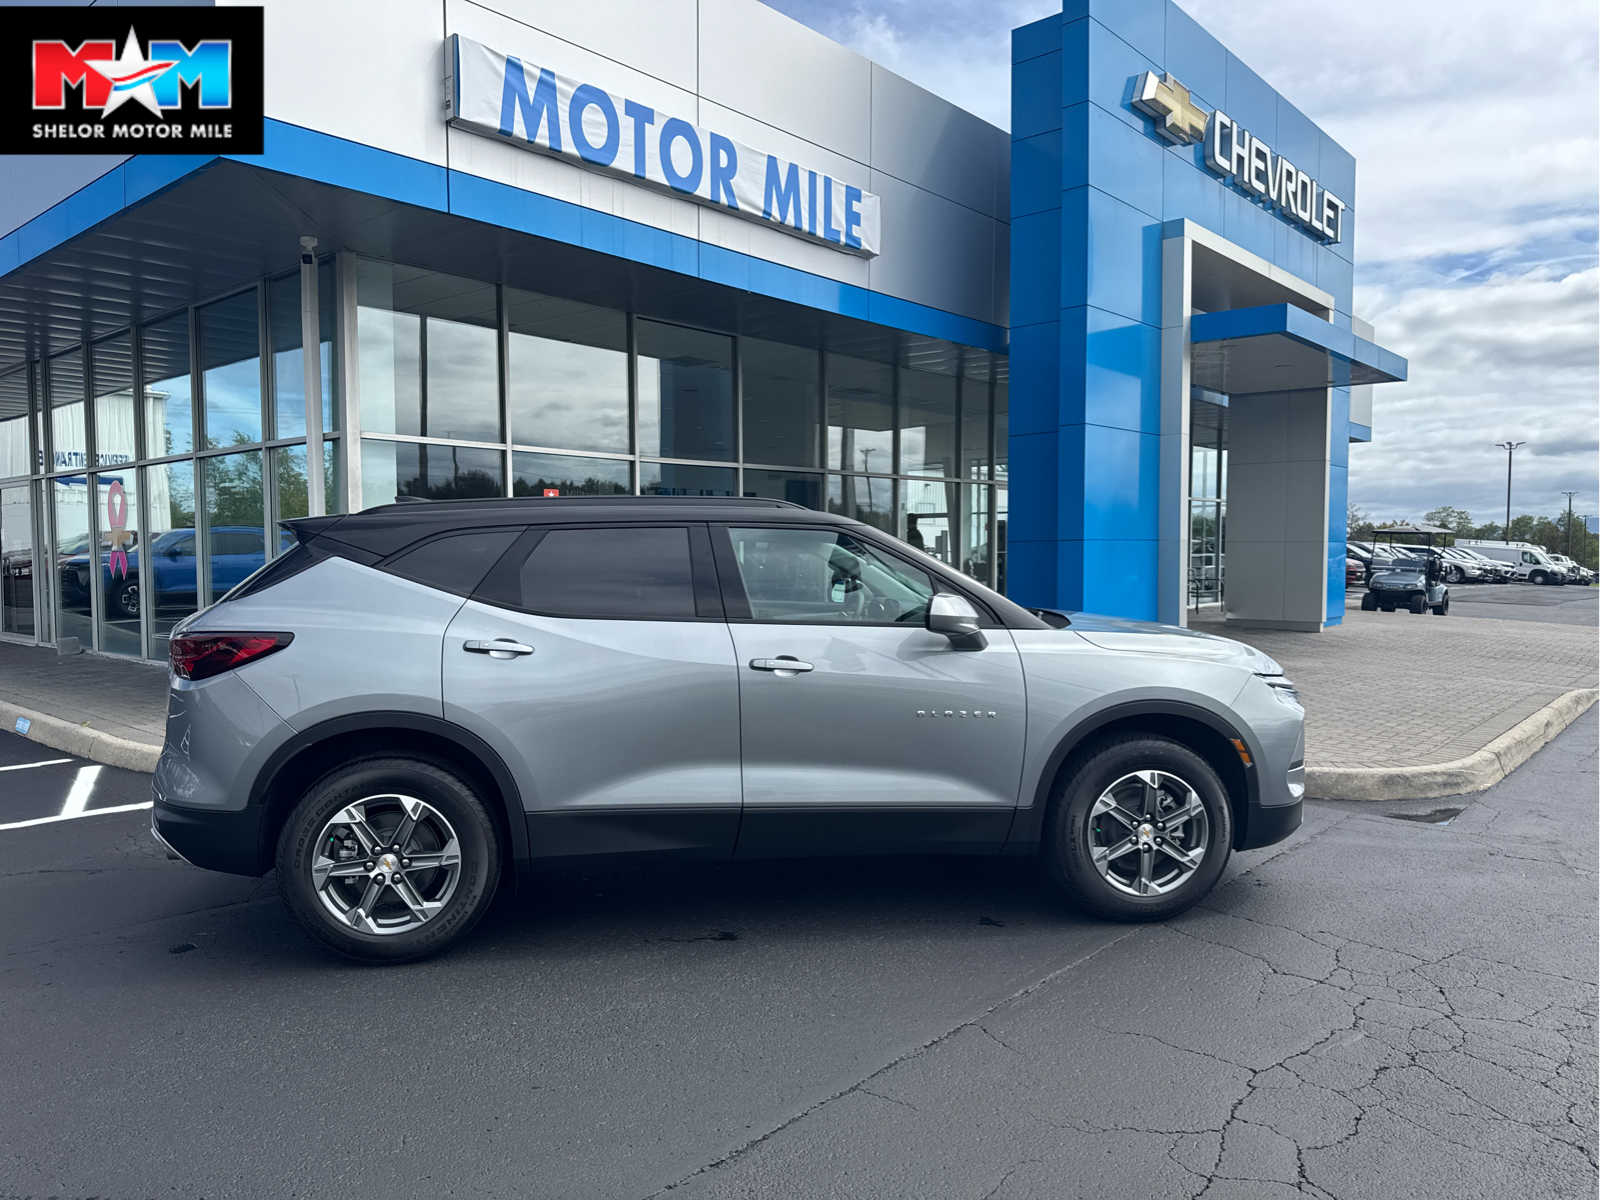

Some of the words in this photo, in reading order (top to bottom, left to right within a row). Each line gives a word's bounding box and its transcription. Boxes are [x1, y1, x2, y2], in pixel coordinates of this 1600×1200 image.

[497, 55, 740, 211] MOTOR
[762, 154, 863, 249] MILE
[1213, 109, 1345, 243] CHEVROLET
[915, 709, 998, 719] BLAZER
